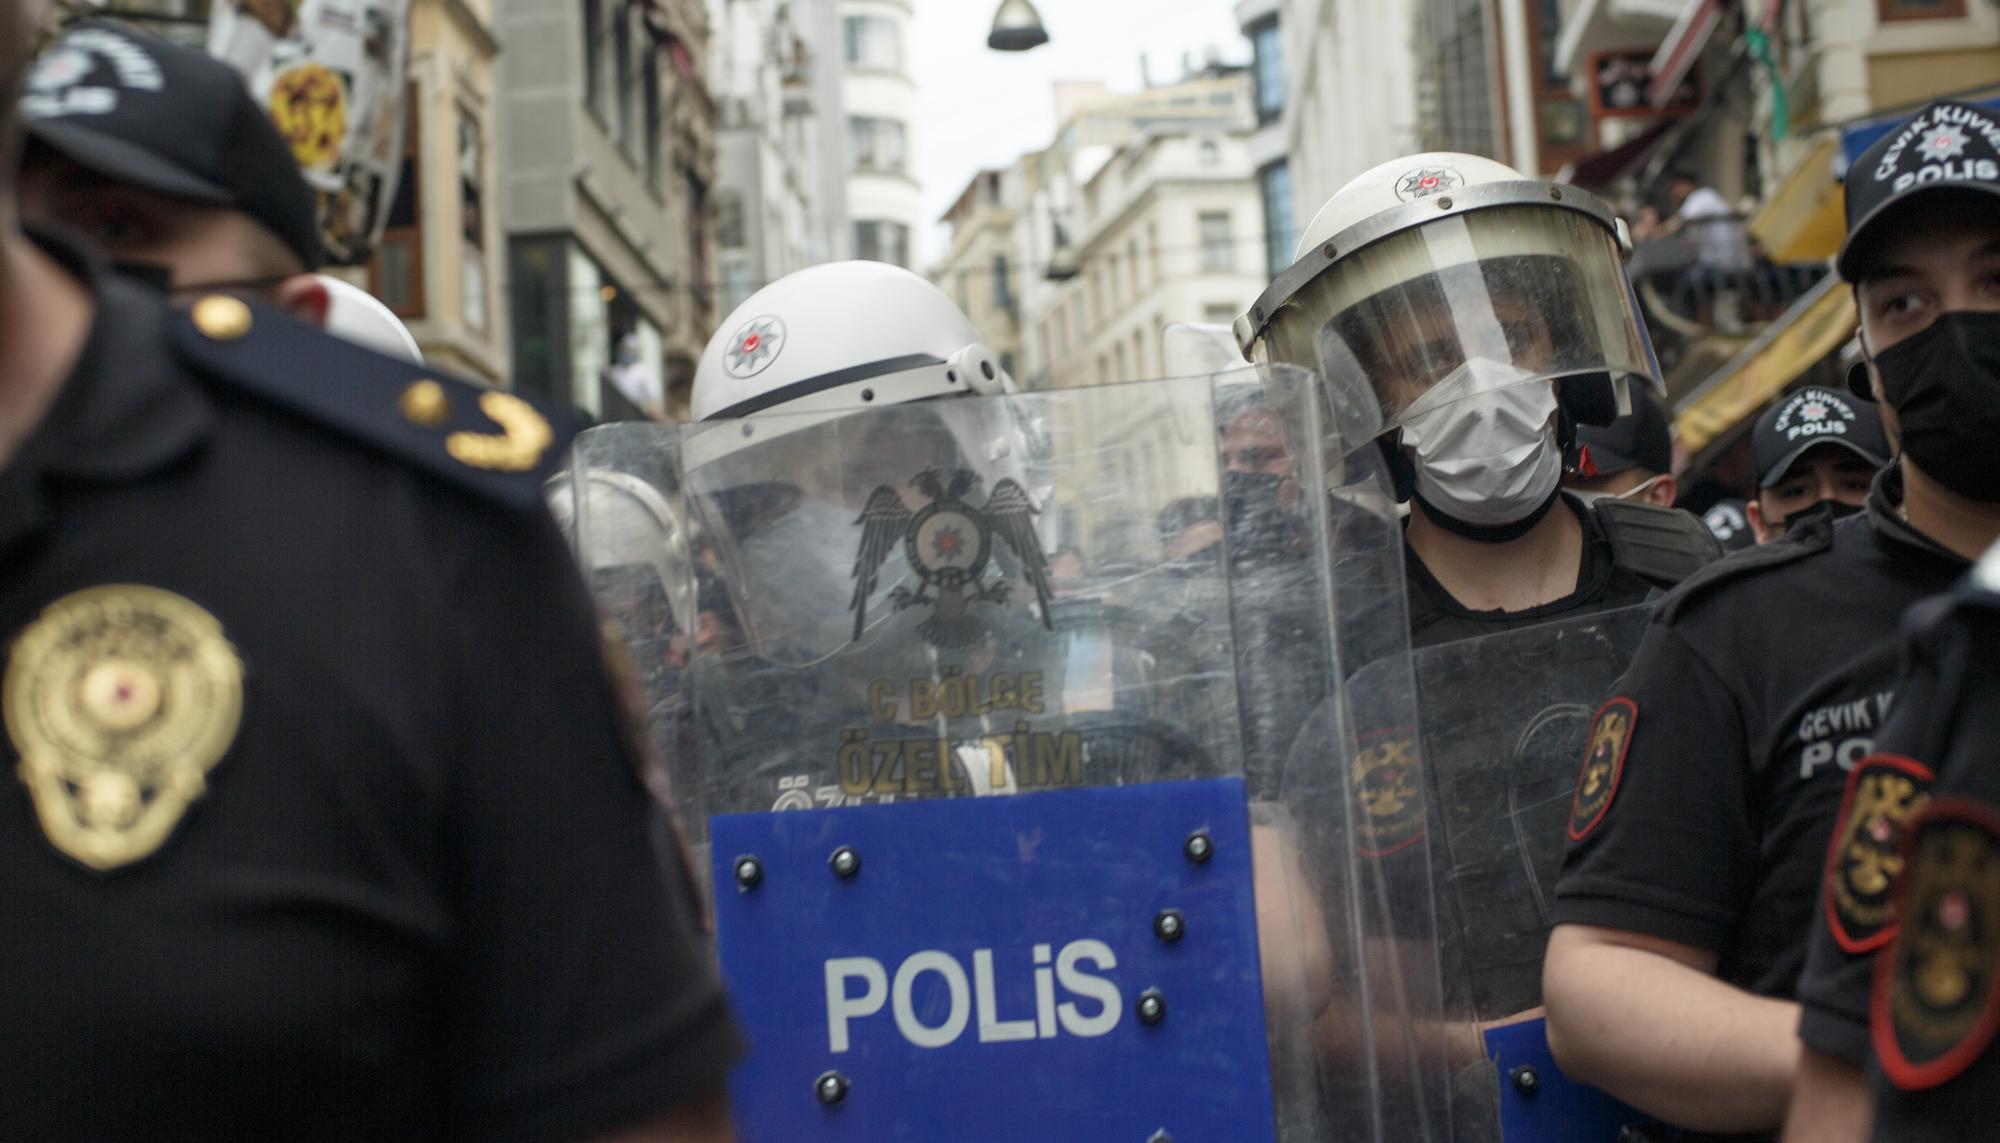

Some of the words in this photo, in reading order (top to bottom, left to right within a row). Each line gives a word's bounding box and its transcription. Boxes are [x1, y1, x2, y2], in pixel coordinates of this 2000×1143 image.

[1893, 159, 1999, 193] POLIS
[1787, 419, 1847, 440] POLIS
[909, 665, 1045, 723] BÖLGE
[838, 727, 966, 797] ÖZEL
[980, 718, 1083, 789] TİM
[1801, 738, 1876, 779] PO
